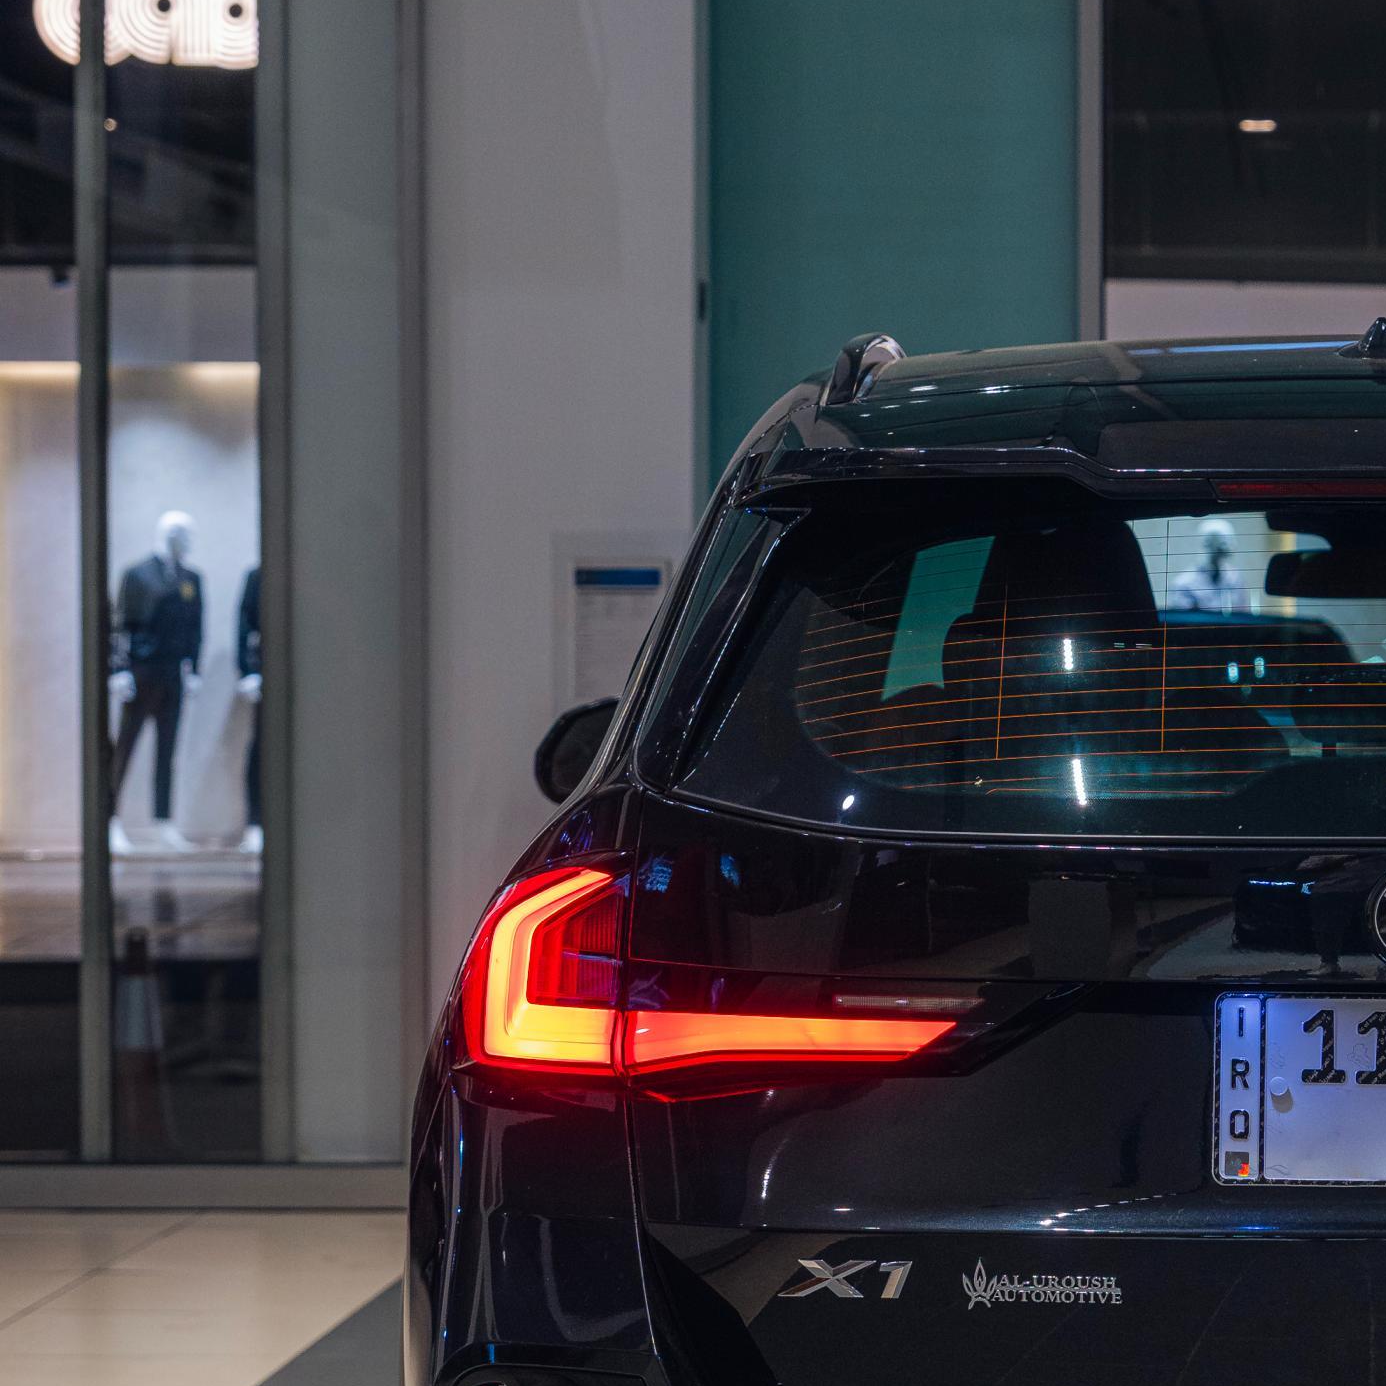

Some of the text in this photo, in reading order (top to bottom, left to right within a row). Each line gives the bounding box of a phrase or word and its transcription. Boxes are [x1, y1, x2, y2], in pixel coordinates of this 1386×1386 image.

[778, 1260, 912, 1298] X1
[998, 1274, 1117, 1289] AL-UROUSH
[990, 1289, 1123, 1305] AUTOMOTIVE
